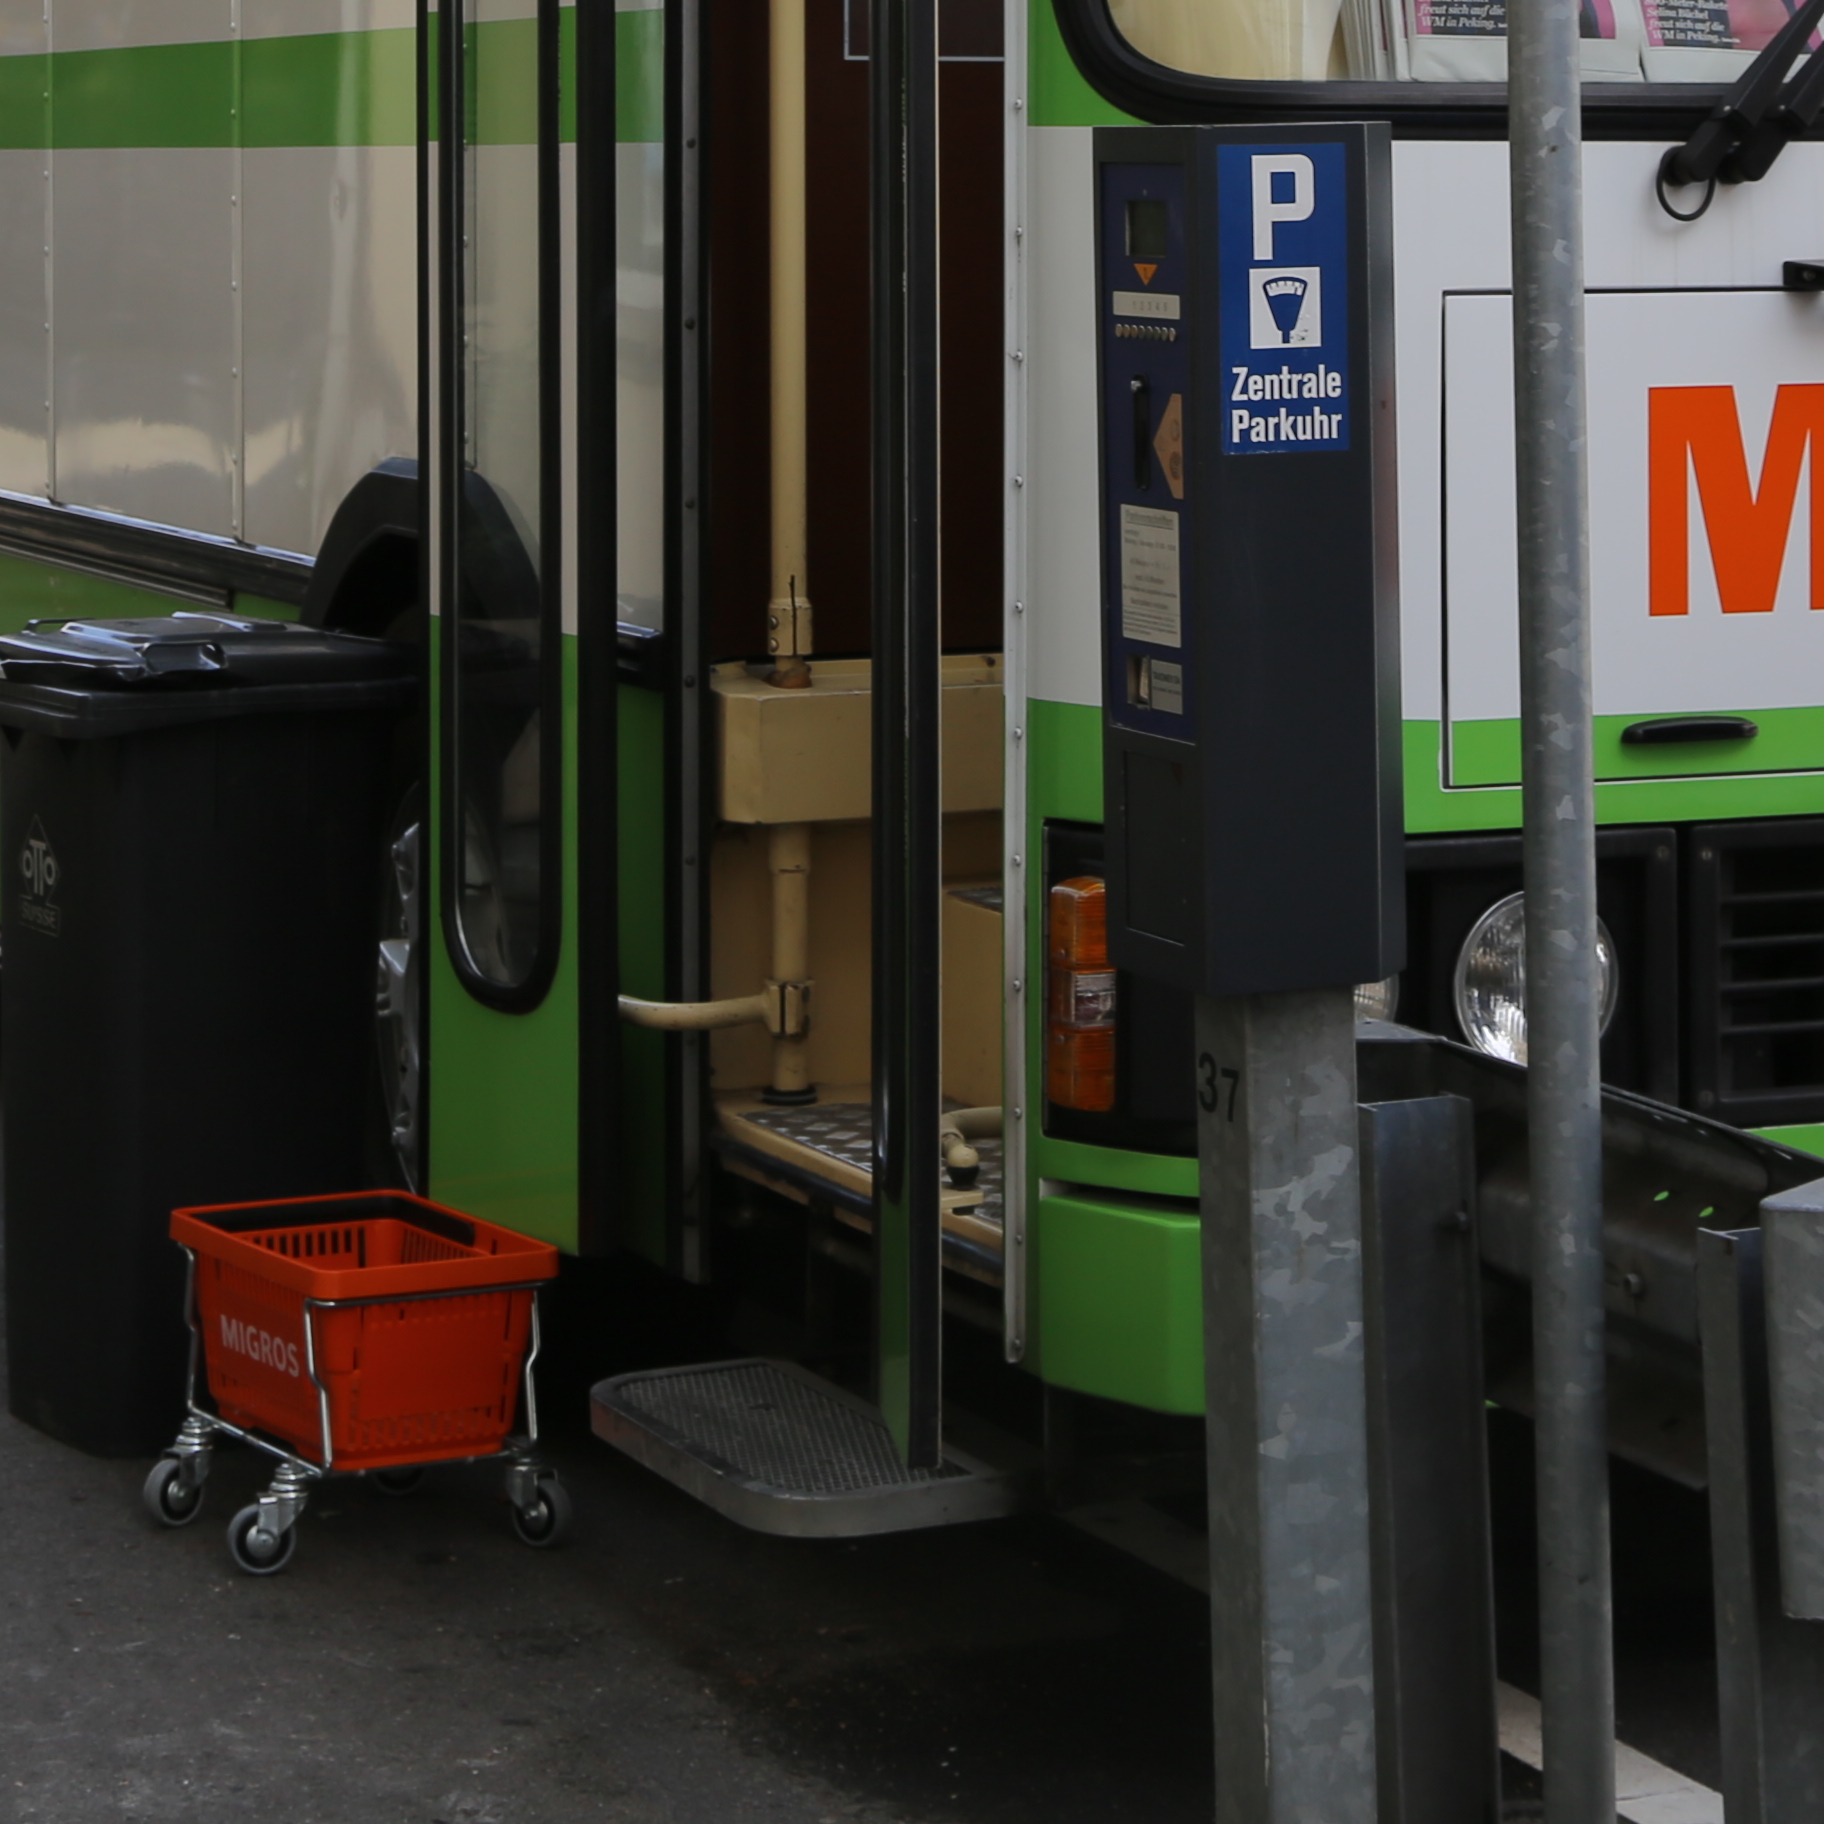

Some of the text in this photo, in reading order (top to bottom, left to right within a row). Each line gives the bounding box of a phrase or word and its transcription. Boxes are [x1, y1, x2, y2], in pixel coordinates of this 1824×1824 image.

[1251, 153, 1315, 260] P
[1231, 364, 1343, 402] Zentrale
[1231, 406, 1343, 444] Parkuhr
[1197, 1051, 1240, 1123] 37
[220, 1313, 299, 1378] MIGROS
